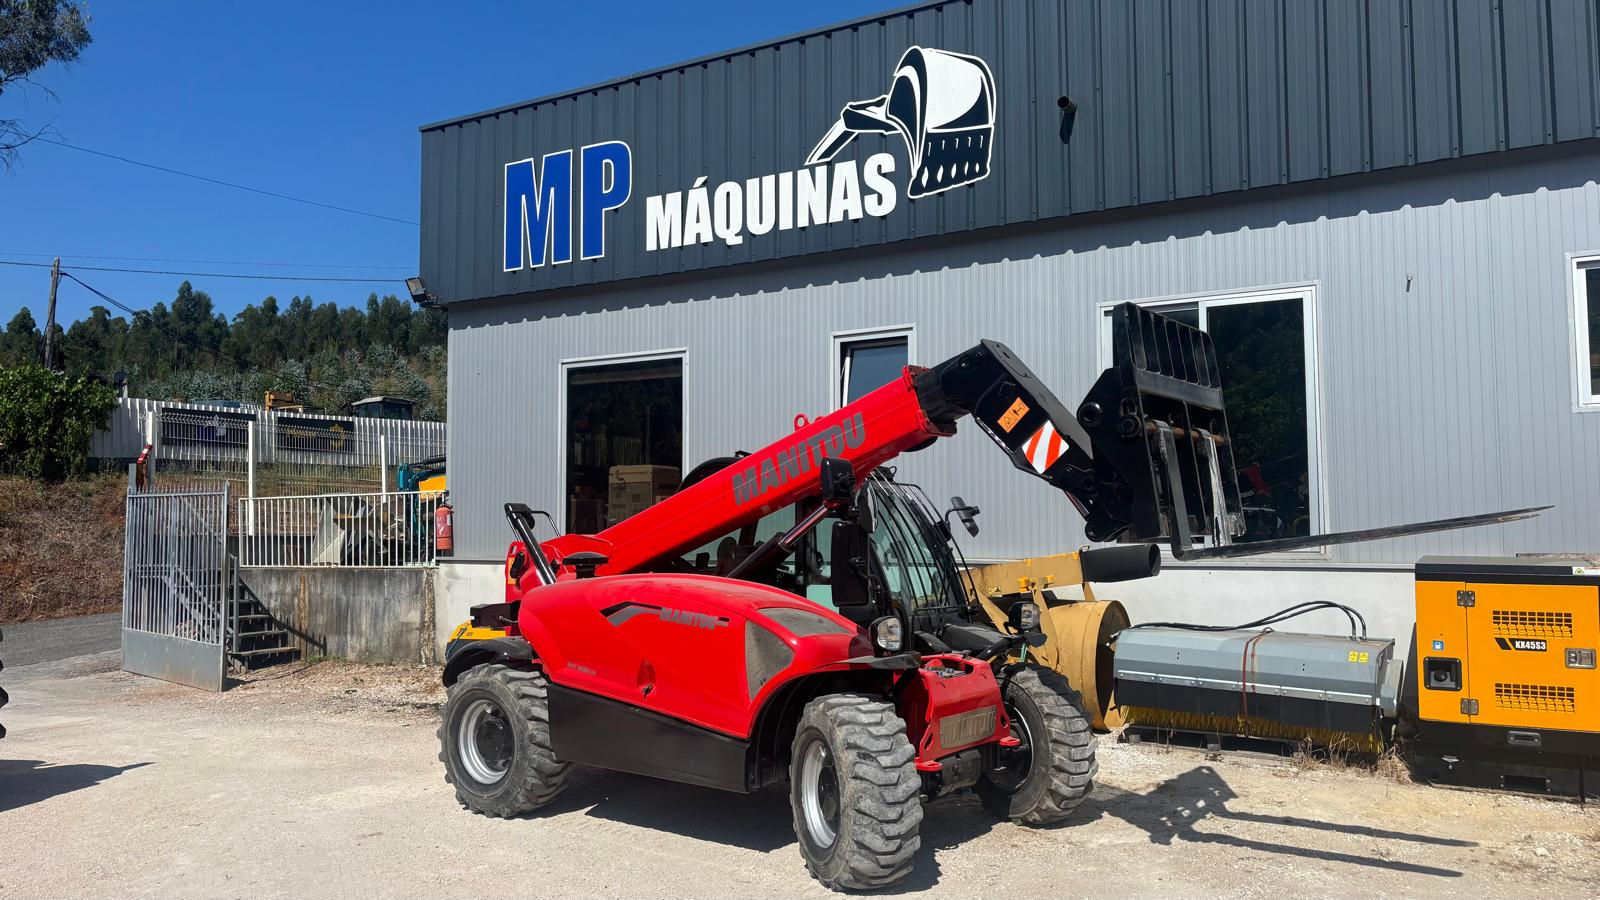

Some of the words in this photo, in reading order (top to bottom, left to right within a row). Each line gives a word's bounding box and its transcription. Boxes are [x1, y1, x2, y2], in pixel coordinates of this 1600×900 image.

[503, 140, 632, 272] MP
[646, 152, 897, 251] MÁQUINAS
[732, 412, 866, 507] MANITOU
[660, 607, 718, 630] MANITOU
